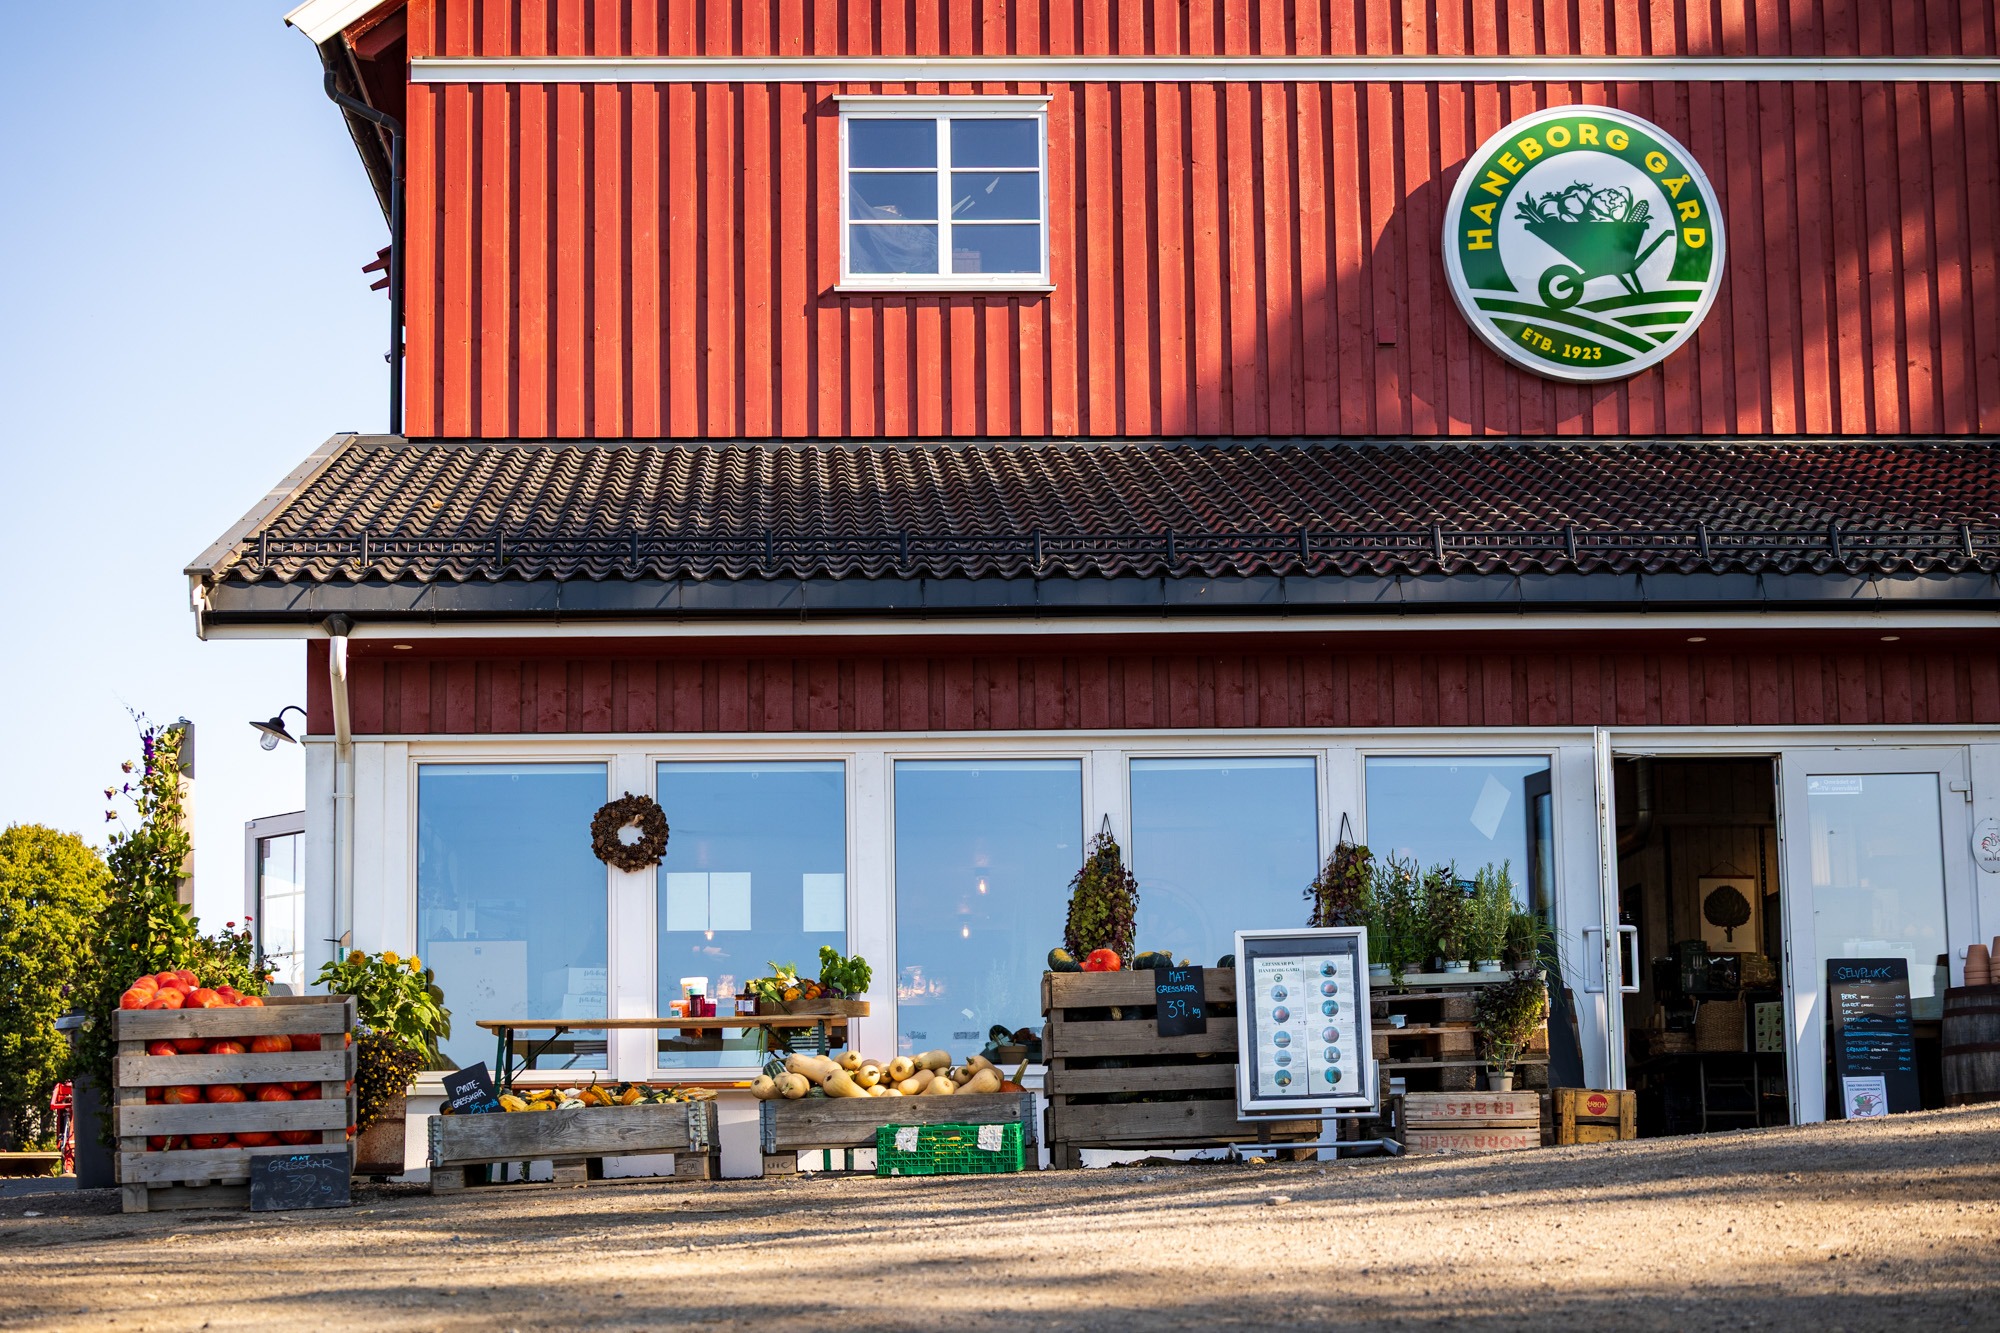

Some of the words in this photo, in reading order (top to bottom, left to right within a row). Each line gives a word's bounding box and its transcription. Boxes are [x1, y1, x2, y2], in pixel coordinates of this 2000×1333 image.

[1467, 123, 1630, 251] HANEBORG
[1645, 150, 1706, 249] GÅRD
[1521, 326, 1556, 353] ETB.
[1562, 343, 1602, 360] 1923
[1168, 970, 1191, 983] MAT-
[1837, 965, 1892, 980] SELVPLUKK
[1156, 984, 1198, 994] GRESSKAR
[1192, 1007, 1201, 1018] kg
[455, 1079, 480, 1095] PYNTE-
[452, 1088, 487, 1109] GRESSKAR
[1494, 1102, 1514, 1115] ER
[1473, 1135, 1526, 1149] NORA
[267, 1158, 345, 1173] GRESSKAR
